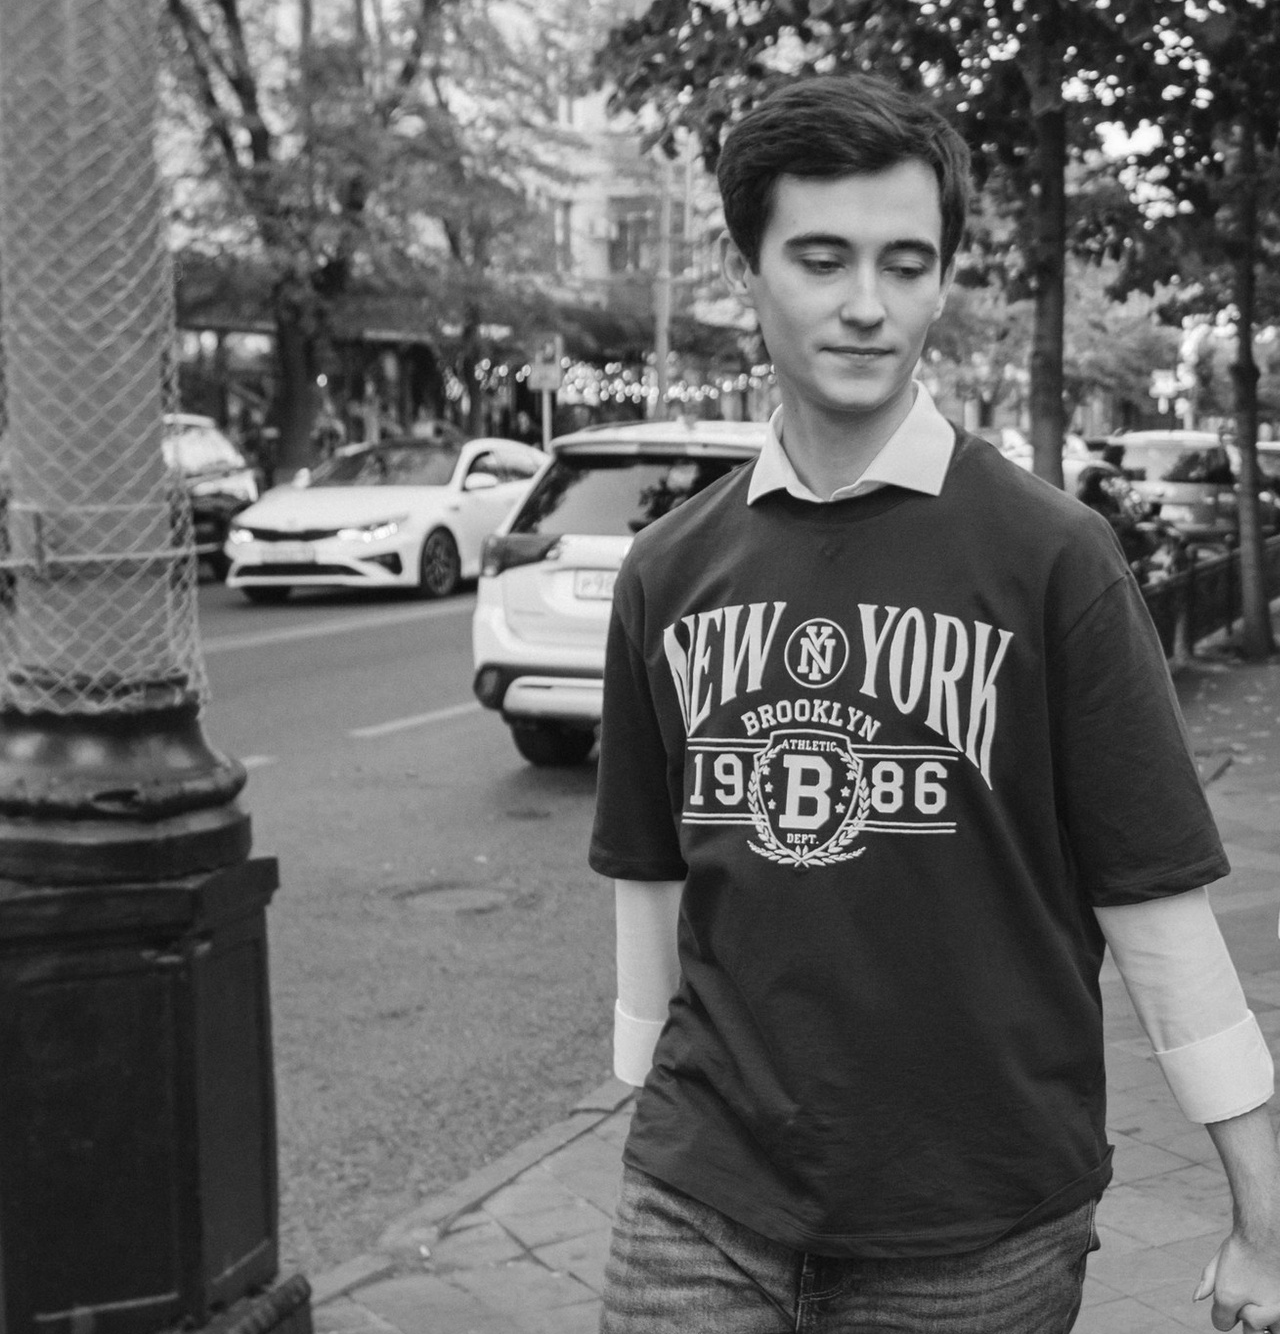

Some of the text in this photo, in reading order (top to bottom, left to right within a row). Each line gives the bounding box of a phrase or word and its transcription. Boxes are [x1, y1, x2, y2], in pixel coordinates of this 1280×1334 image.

[663, 601, 787, 738] NEW
[857, 603, 1014, 791] YORK
[740, 698, 882, 742] BROOKLYN
[781, 738, 837, 752] ATHLETIC
[689, 753, 948, 815] 19 86
[779, 753, 833, 830] B
[786, 832, 820, 845] DEPT.
